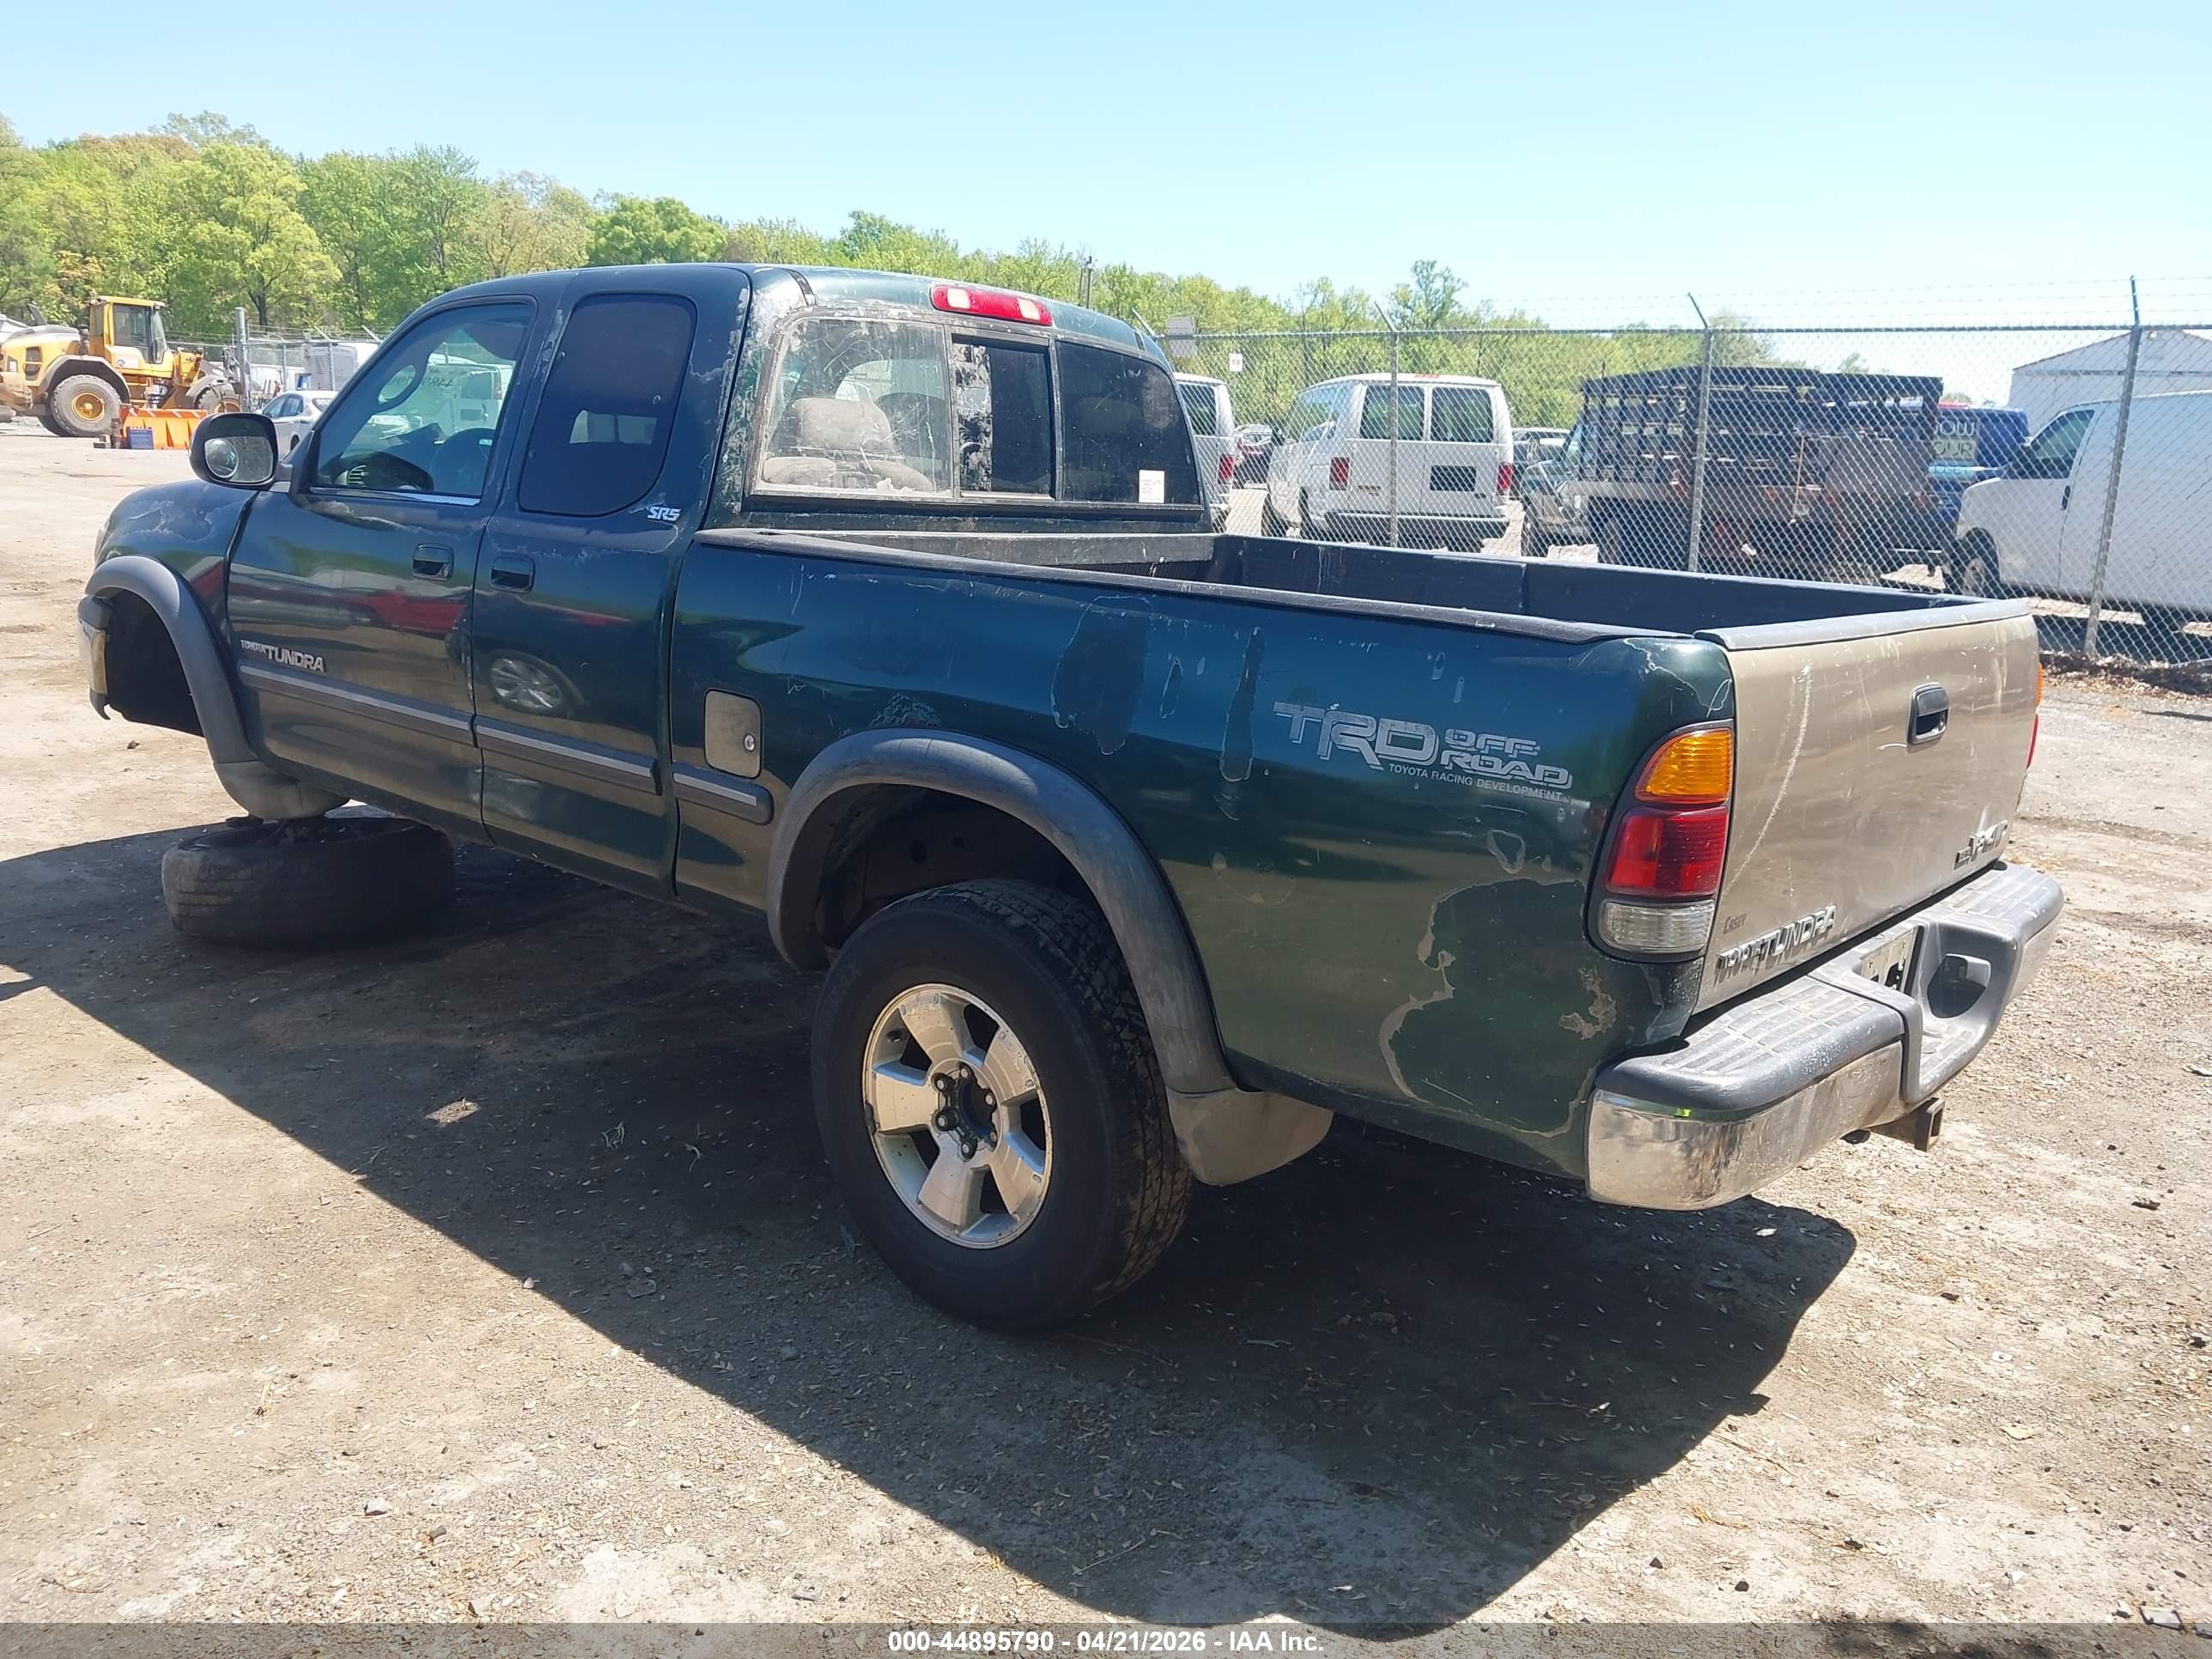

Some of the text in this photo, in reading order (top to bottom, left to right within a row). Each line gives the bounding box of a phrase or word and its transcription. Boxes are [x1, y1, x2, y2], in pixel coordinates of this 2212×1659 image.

[647, 507, 681, 521] SR5
[265, 645, 325, 672] TUNDRA
[1273, 701, 1439, 770] TRD
[1444, 728, 1541, 758] OFF
[1389, 763, 1565, 802] TOYOTA RACING DEVELOPMENT
[1440, 750, 1573, 789] ROAD
[1759, 905, 1836, 963] TUNDRA
